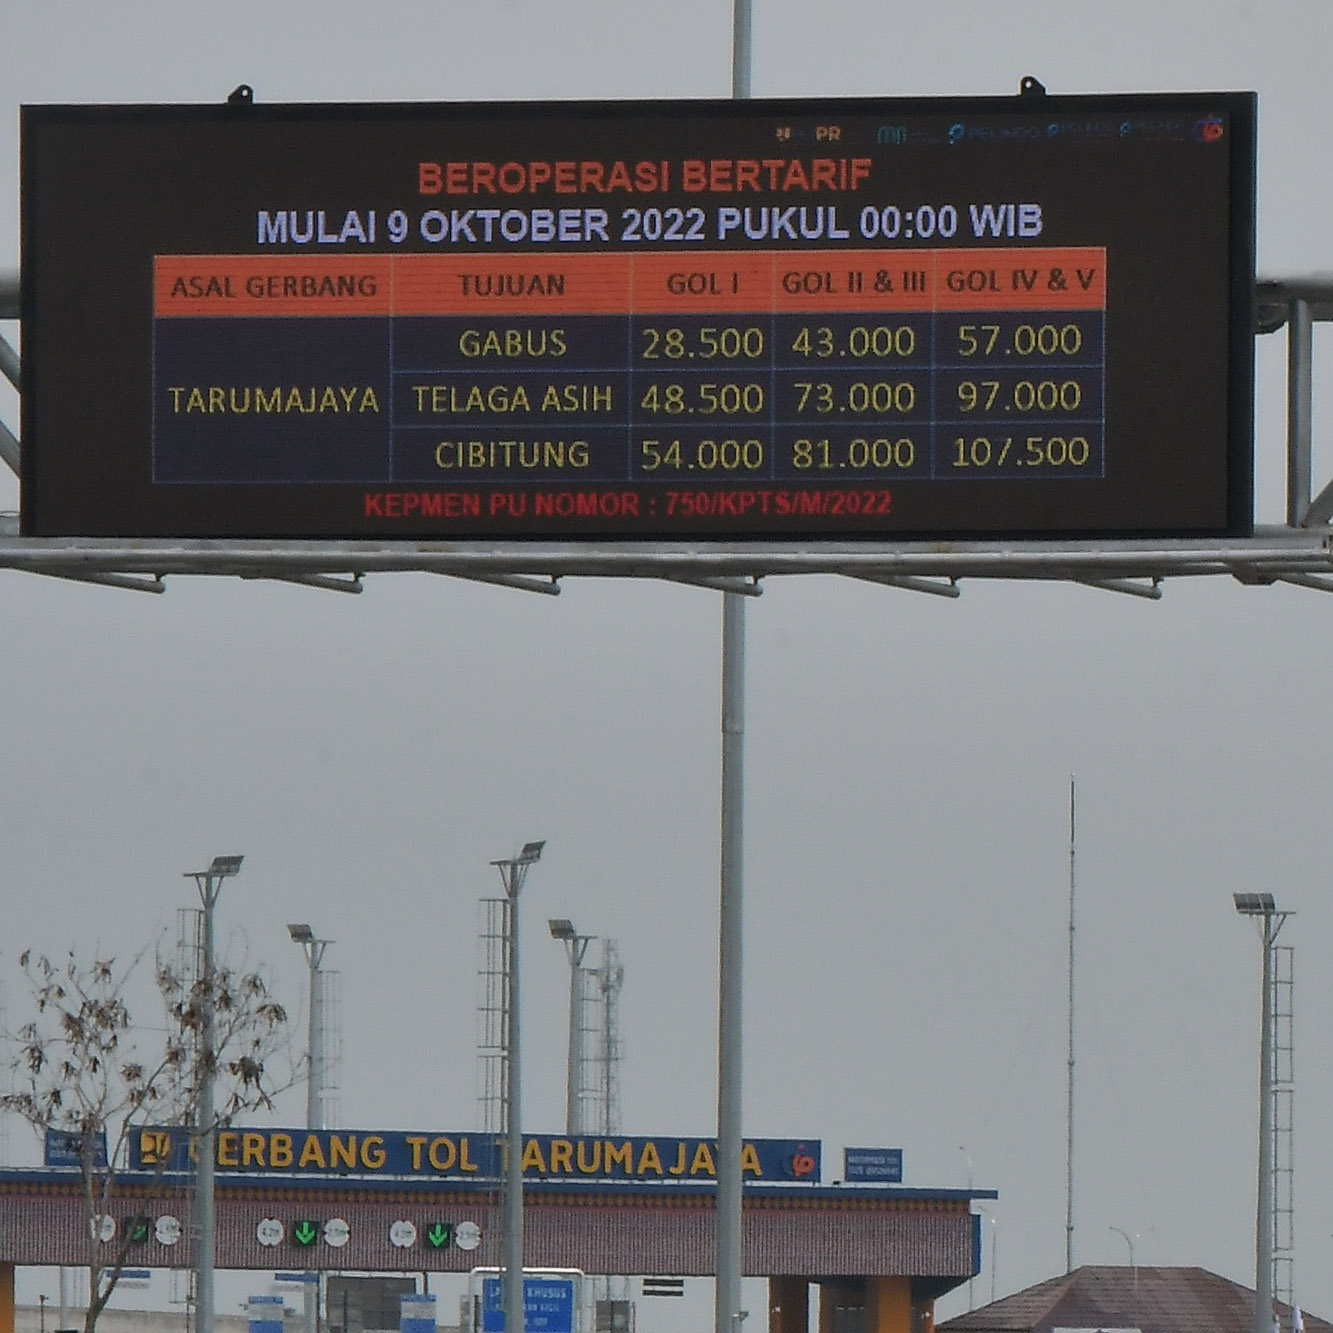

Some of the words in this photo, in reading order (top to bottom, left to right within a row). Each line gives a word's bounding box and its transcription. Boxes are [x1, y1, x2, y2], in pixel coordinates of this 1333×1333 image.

[417, 162, 670, 195] BEROPERASI
[682, 158, 872, 192] BERTARIF
[257, 210, 376, 244] MULAI
[387, 209, 409, 243] 9
[419, 208, 610, 243] OKTOBER
[621, 207, 706, 241] 2022
[717, 206, 850, 240] PUKUL
[859, 204, 958, 239] 00:00
[968, 203, 1043, 238] WIB
[170, 276, 236, 299] ASAL
[245, 275, 377, 299] GERBANG
[457, 274, 565, 297] TUJUAN
[666, 273, 721, 296] GOL
[732, 272, 739, 295] I
[781, 272, 837, 295] GOL
[848, 272, 863, 294] II
[873, 270, 894, 294] &
[903, 271, 926, 293] III
[946, 270, 1001, 293] GOL
[1011, 269, 1039, 292] IV
[1047, 268, 1069, 292] &
[1075, 269, 1096, 291] V
[458, 329, 567, 356] GABUS
[642, 327, 764, 358] 28.500
[791, 326, 915, 357] 43.000
[958, 324, 1082, 356] 57.000
[167, 386, 380, 413] TARUMAJAYA
[412, 385, 531, 413] TELAGA
[541, 384, 612, 412] ASIH
[641, 384, 764, 413] 48.500
[793, 383, 915, 412] 73.000
[957, 380, 1082, 411] 97.000
[435, 440, 589, 468] CIBITUNG
[642, 440, 763, 470] 54.000
[792, 438, 915, 468] 81.000
[365, 492, 480, 517] KEPMEN
[489, 492, 527, 516] PU
[534, 491, 639, 517] NOMOR
[666, 490, 892, 517] 750/KPTS/M/2022
[406, 1136, 479, 1171] TOL
[495, 1137, 763, 1177] TARUMAJAA
